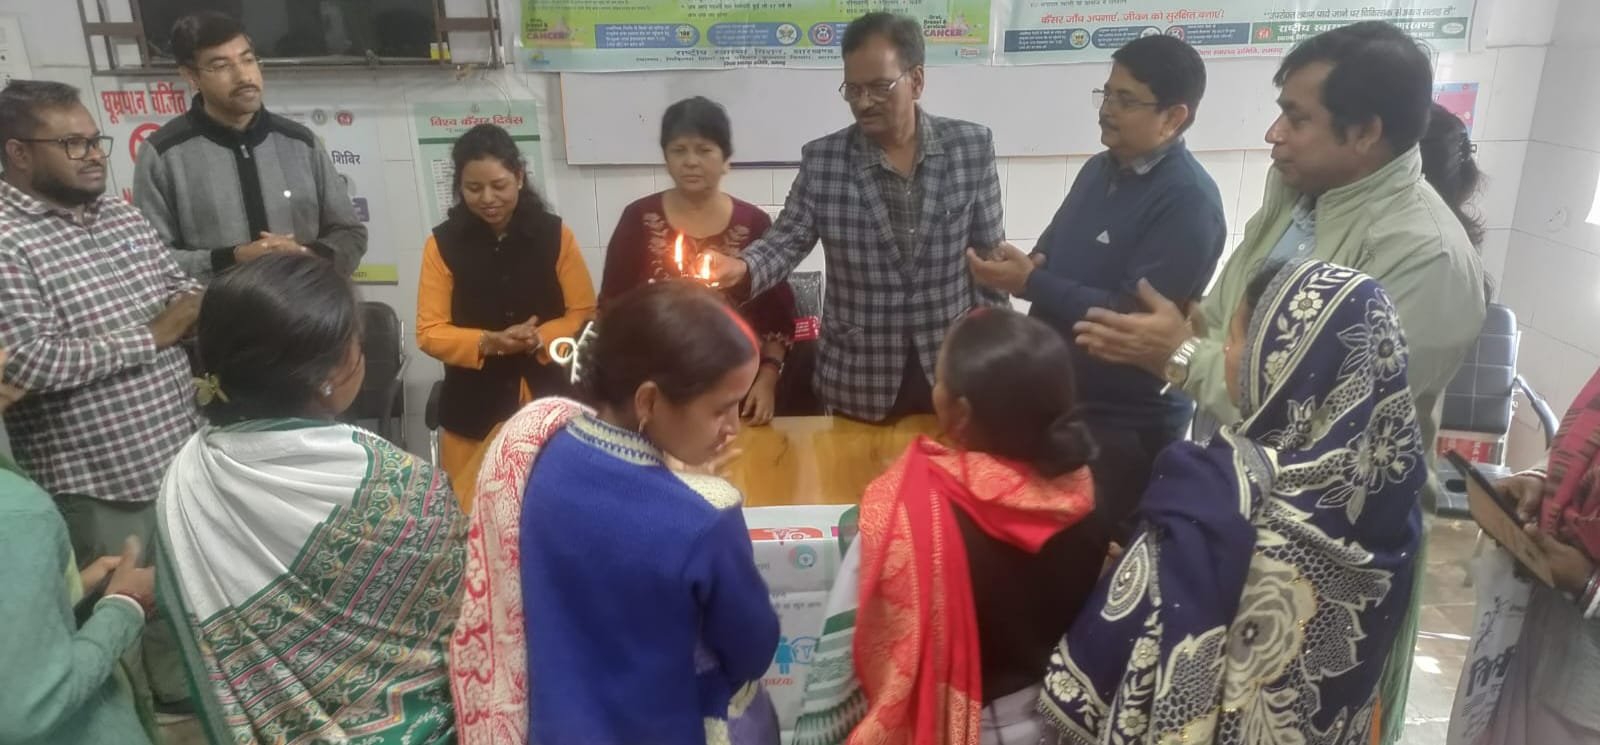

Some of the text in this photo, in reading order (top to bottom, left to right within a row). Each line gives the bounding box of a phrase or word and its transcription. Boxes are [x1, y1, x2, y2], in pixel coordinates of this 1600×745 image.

[1150, 11, 1164, 21] को
[526, 31, 567, 40] CANCER
[924, 28, 963, 38] CANCER
[149, 81, 186, 115] वर्जित
[493, 114, 524, 125] दिवस
[331, 150, 361, 165] शिविर
